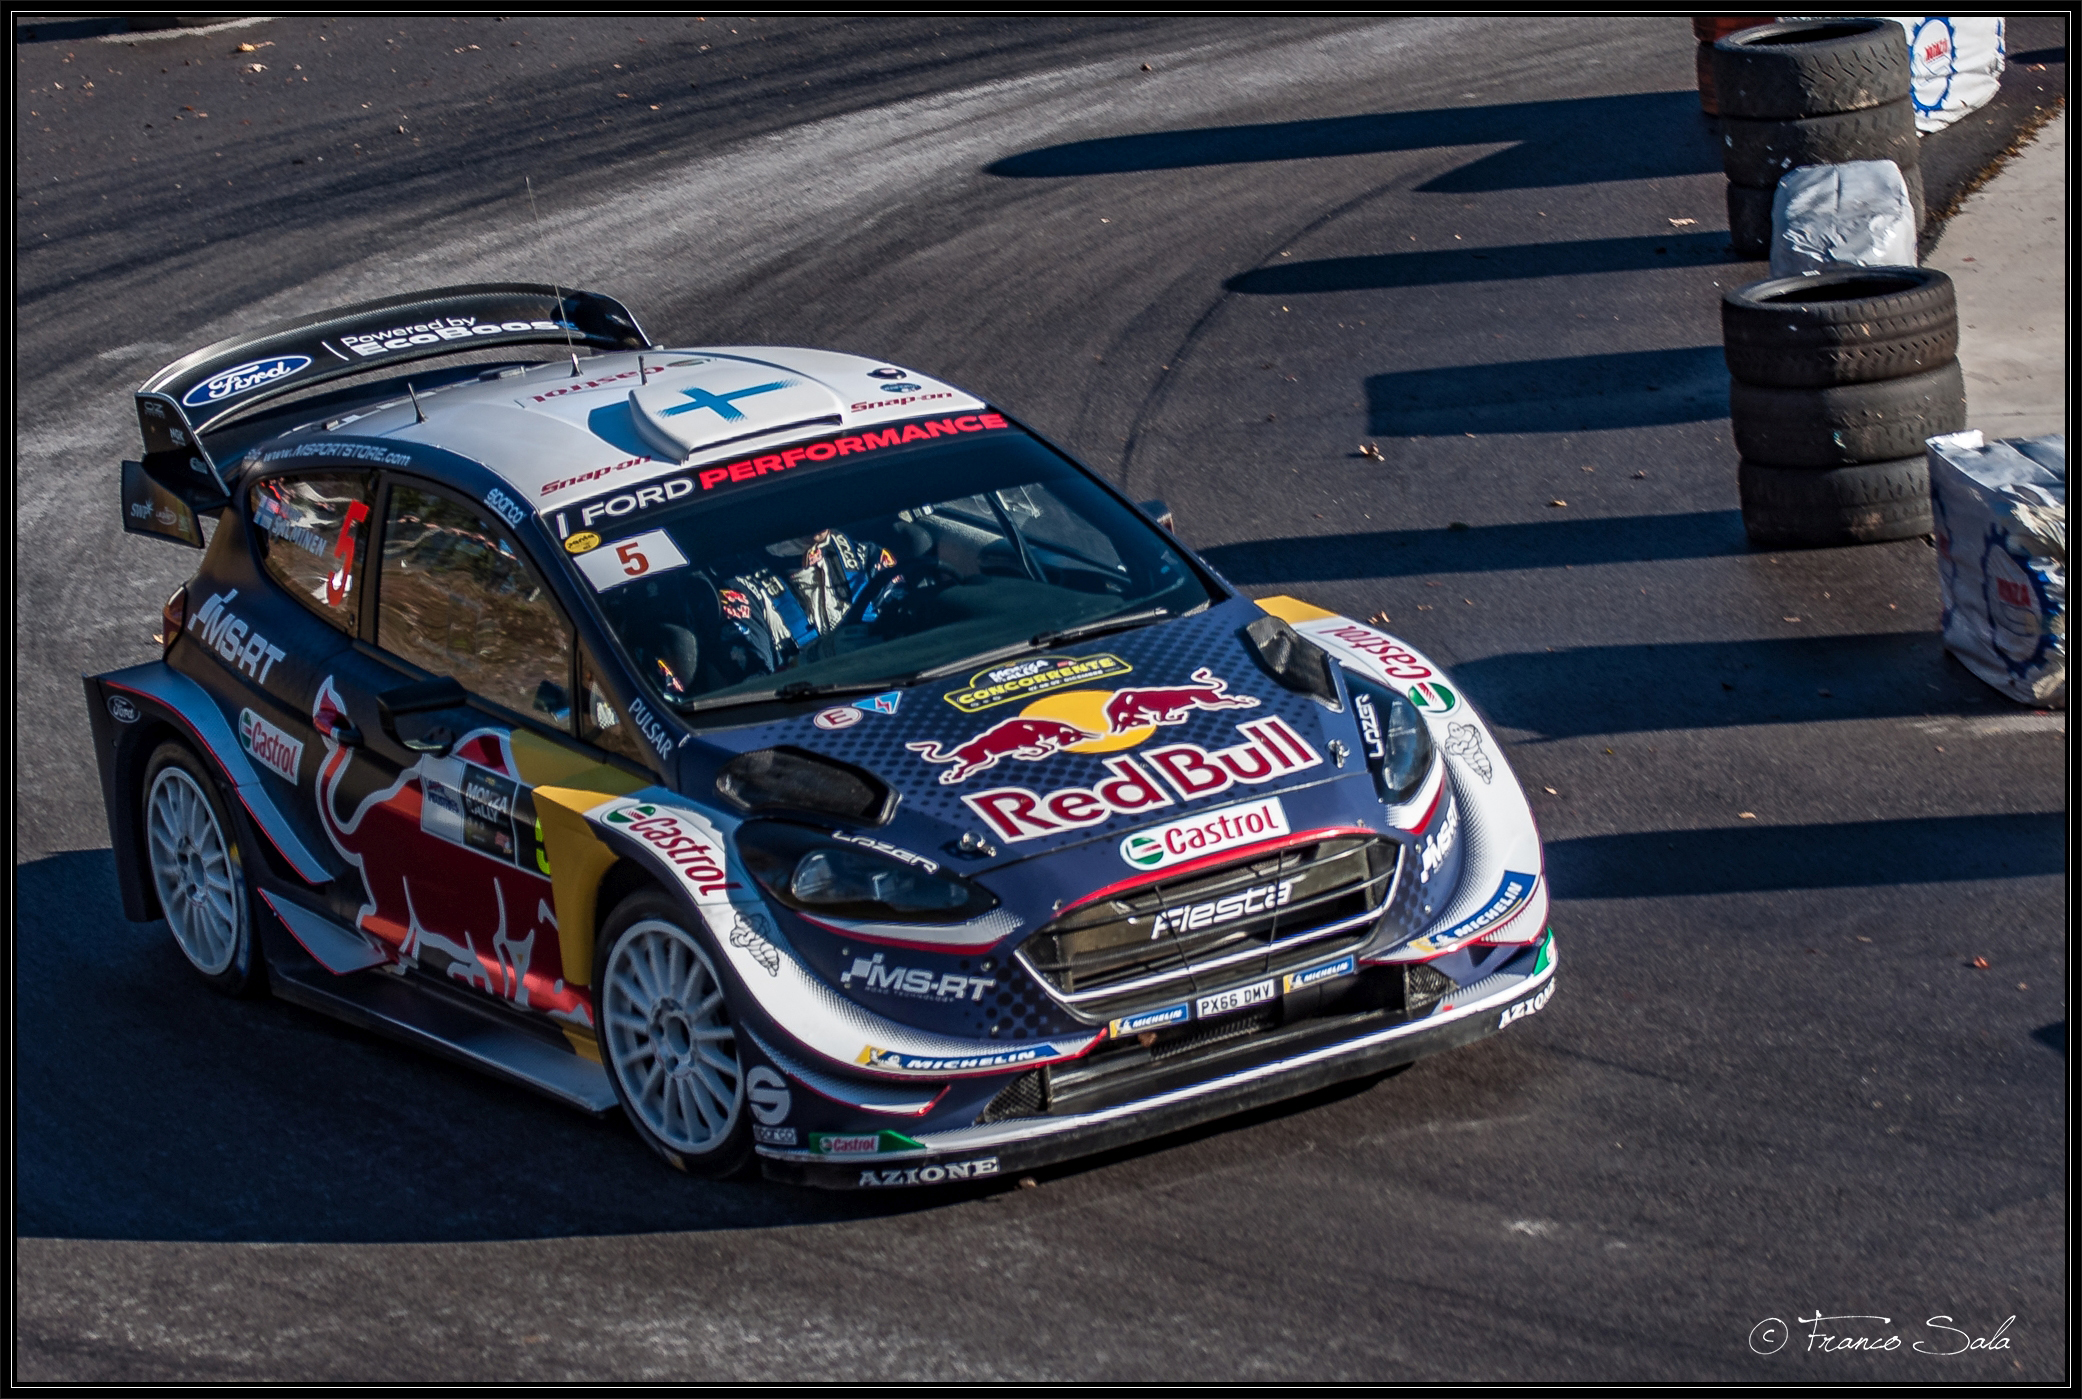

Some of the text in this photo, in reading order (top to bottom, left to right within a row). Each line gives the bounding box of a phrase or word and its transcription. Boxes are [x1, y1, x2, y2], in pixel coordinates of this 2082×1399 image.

[340, 315, 476, 347] Powered by
[207, 361, 292, 399] Ford
[532, 366, 665, 403] Castrol
[851, 392, 953, 413] Snap-on
[540, 455, 651, 497] Snap-on
[581, 412, 1010, 527] FORD PERFORMANCE
[615, 542, 649, 576] 5
[201, 606, 286, 685] MS-RT
[1315, 625, 1432, 679] Castrol
[958, 657, 1117, 705] CONCORRENTE
[112, 700, 136, 721] Ford
[628, 697, 674, 760] PULSAR
[829, 709, 854, 726] E
[1354, 693, 1385, 758] LAZER
[251, 721, 298, 777] Castrol
[465, 782, 508, 813] MONZA
[967, 719, 1317, 840] Red Bull
[1164, 805, 1280, 855] Castrol
[628, 817, 743, 897] Castrol
[831, 829, 940, 875] LAZER
[1453, 881, 1523, 938] MICHELIN
[865, 963, 997, 1001] MS-RT
[1303, 961, 1349, 983] MICHELIN
[1131, 1008, 1184, 1029] MICHELIN
[1200, 986, 1271, 1015] PX66 DMV
[906, 1047, 1037, 1071] MICHELIN
[833, 1137, 876, 1152] Castrol
[859, 1156, 999, 1188] AZIONE
